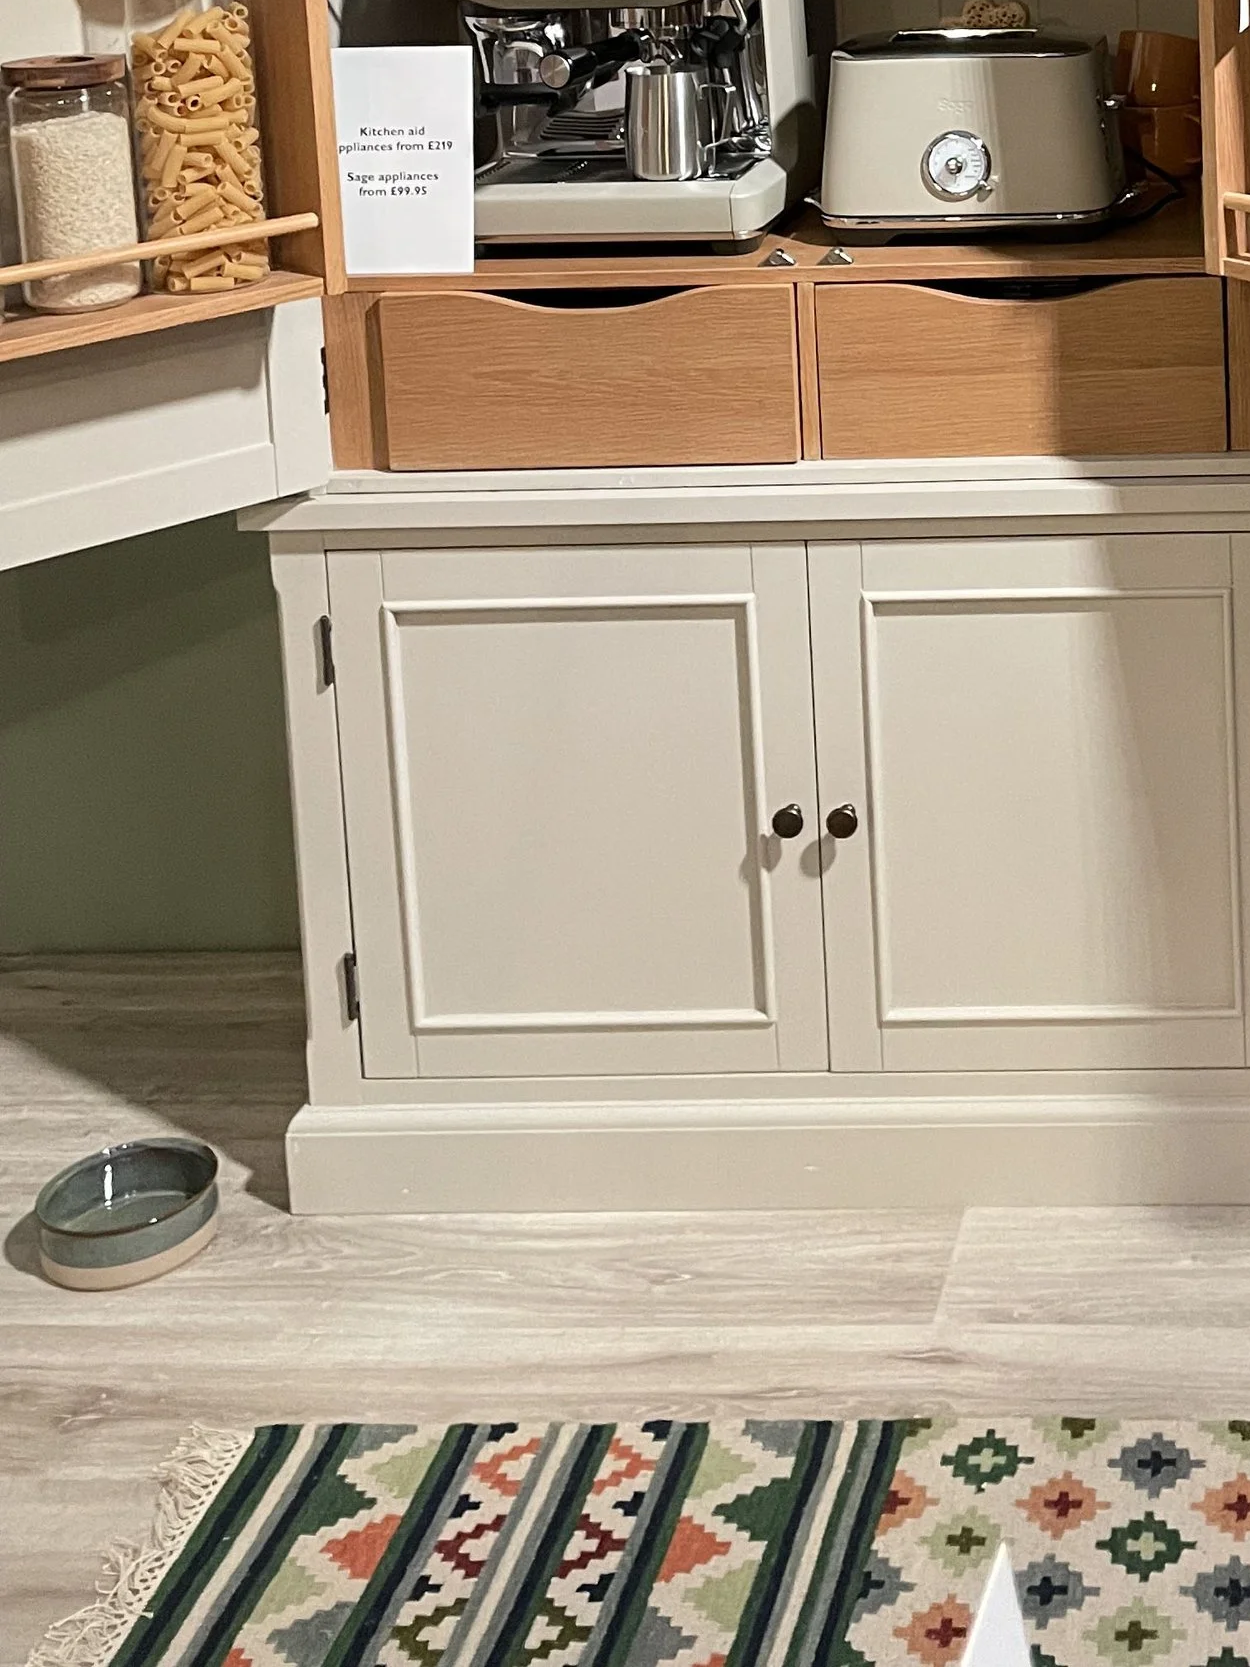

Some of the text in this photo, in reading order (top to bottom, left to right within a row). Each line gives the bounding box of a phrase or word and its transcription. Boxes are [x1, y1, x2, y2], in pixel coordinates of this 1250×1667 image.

[359, 126, 425, 136] Kitchen aid
[339, 141, 453, 154] ppliances from £219
[347, 172, 439, 184] Sage appliances
[359, 186, 427, 197] from £99.95
